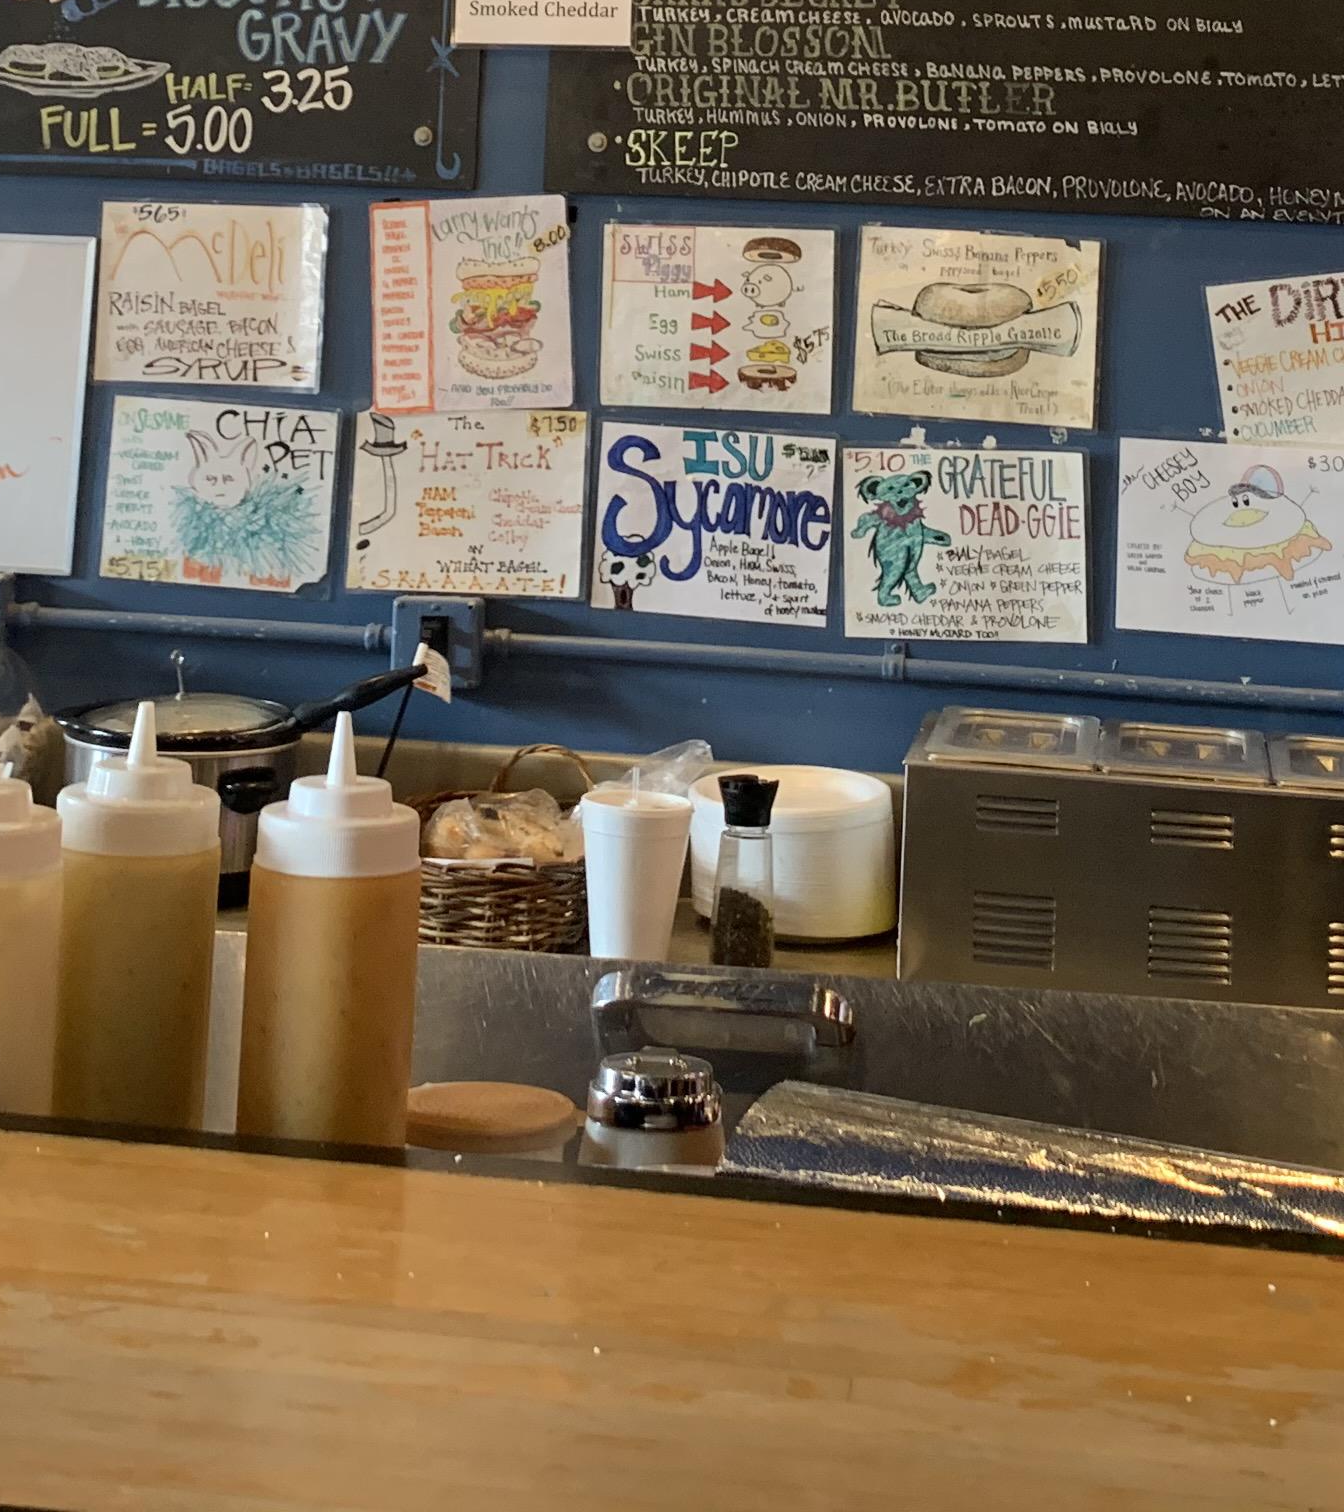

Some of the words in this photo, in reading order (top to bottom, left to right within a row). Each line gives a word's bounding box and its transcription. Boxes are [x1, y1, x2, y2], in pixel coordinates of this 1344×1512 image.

[469, 1, 538, 17] Smoked
[544, 2, 618, 18] Cheddar
[236, 9, 408, 66] GRAVY
[261, 66, 353, 113] 3.25
[40, 105, 136, 153] FULL
[164, 104, 253, 155] 5.00
[625, 130, 739, 168] SKEEP
[109, 291, 174, 316] RAISIN
[655, 286, 690, 298] Ham
[1215, 294, 1261, 323] THE
[649, 314, 677, 334] Egg
[883, 330, 907, 343] The
[635, 345, 681, 362] Swiss
[143, 357, 287, 382] SYRUP
[448, 416, 484, 431] The
[265, 442, 333, 480] PET
[683, 431, 773, 481] ISU
[910, 454, 931, 465] THE
[938, 454, 1066, 501] GRATEFUL
[1172, 470, 1211, 502] BOY
[602, 435, 831, 581] Sycamore
[710, 536, 738, 554] Apple
